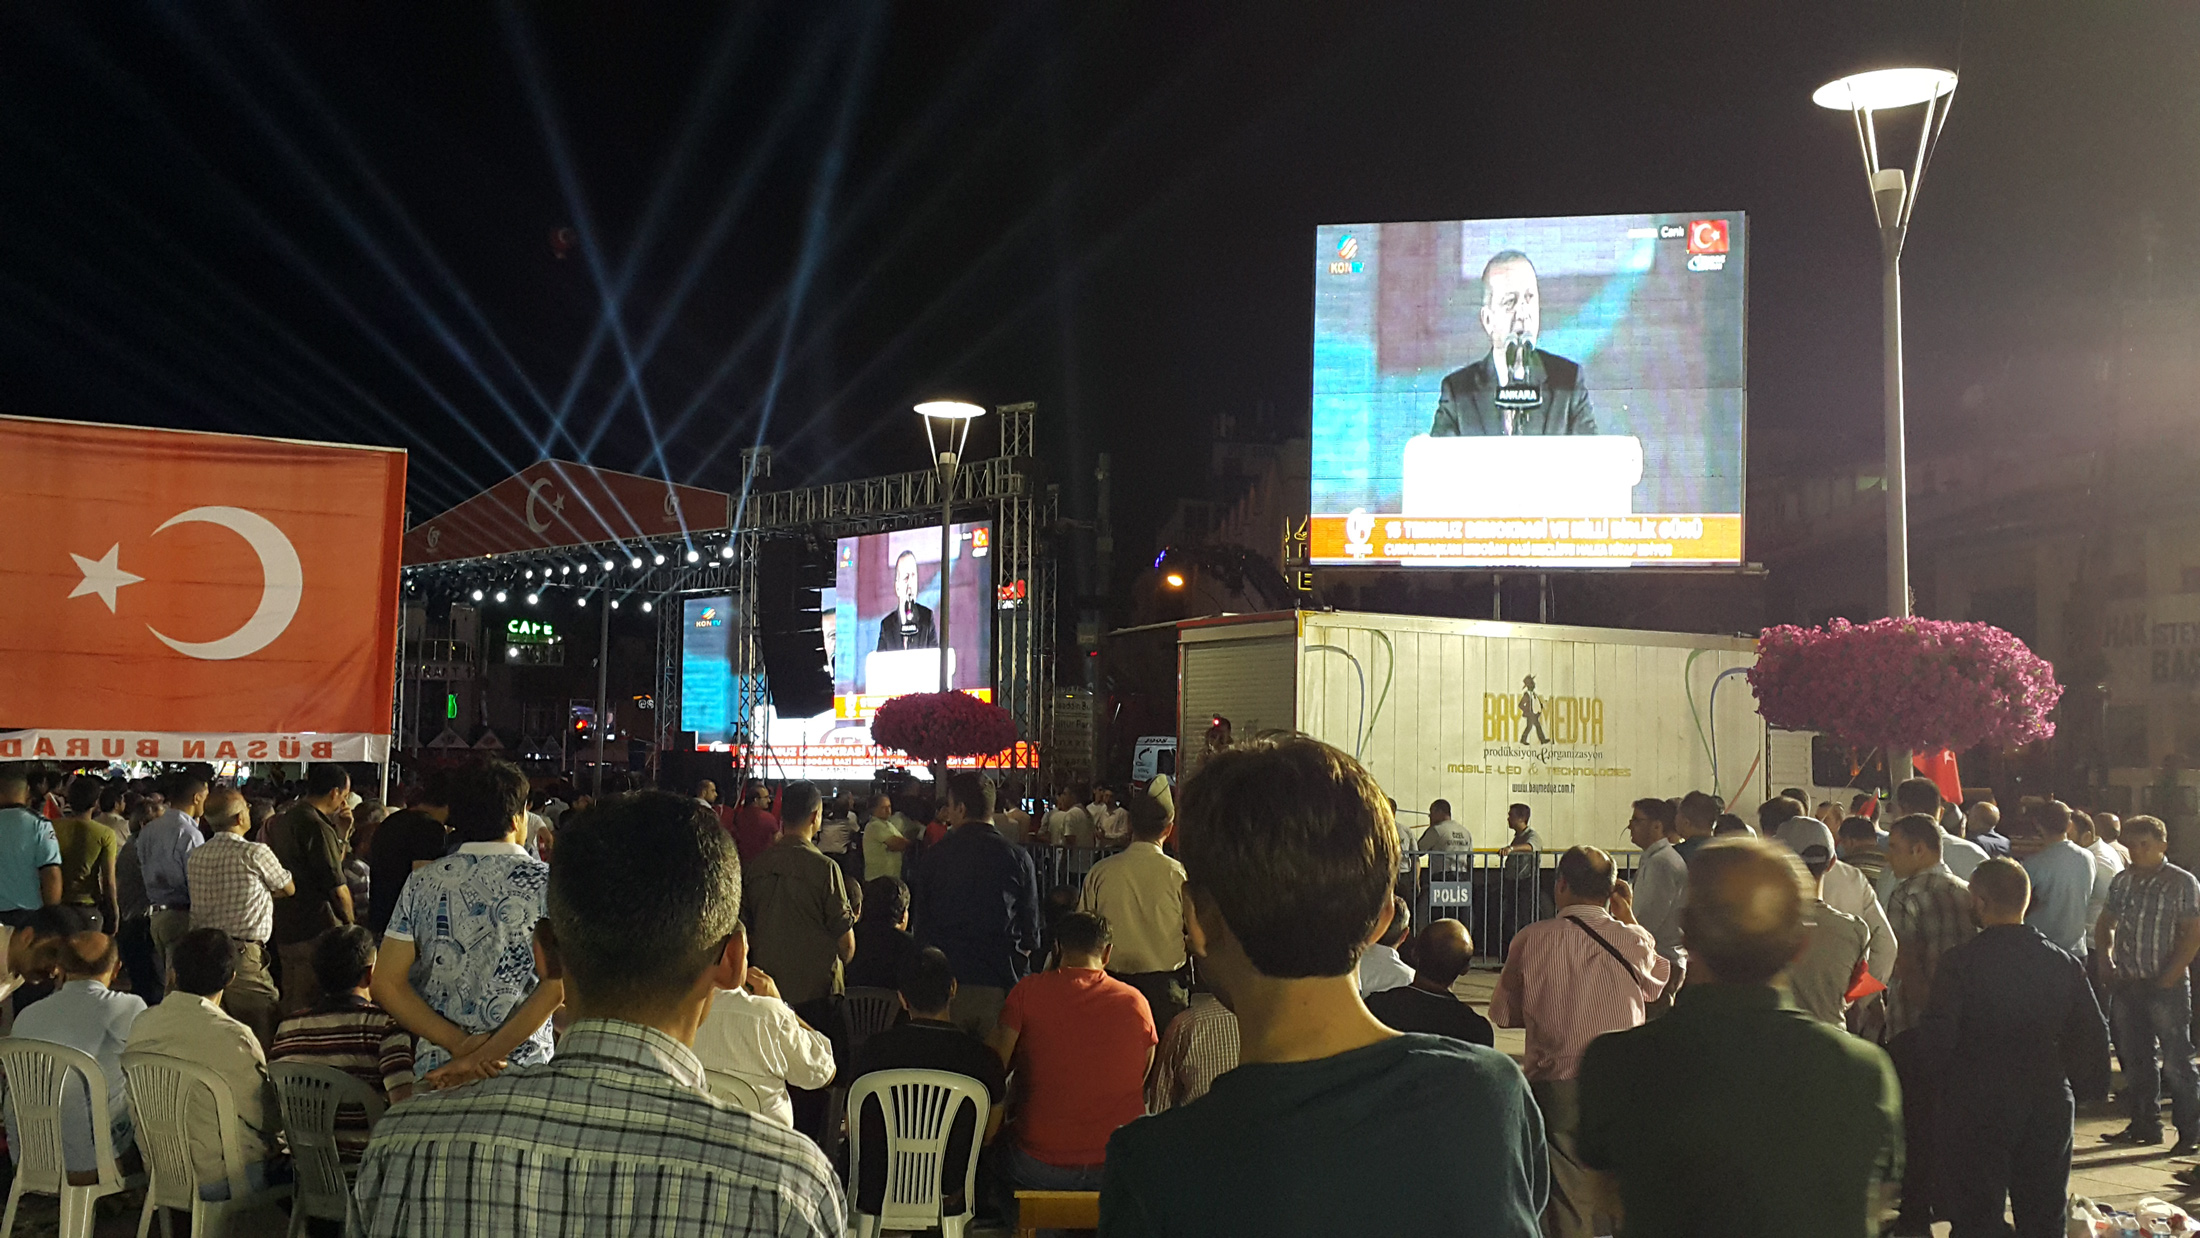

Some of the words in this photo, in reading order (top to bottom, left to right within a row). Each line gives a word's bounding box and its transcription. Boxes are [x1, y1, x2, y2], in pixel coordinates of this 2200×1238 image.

[1499, 389, 1537, 401] ANKARA
[1403, 521, 1463, 539] TEMMUZ
[508, 619, 553, 635] CAFE
[1483, 692, 1523, 743] BAY
[1540, 695, 1605, 745] MEDYA
[1483, 746, 1537, 761] prodüksiyon
[1548, 749, 1603, 761] organizasyon
[1545, 766, 1632, 777] TECHNOLOGIES
[1433, 886, 1469, 903] POLİS
